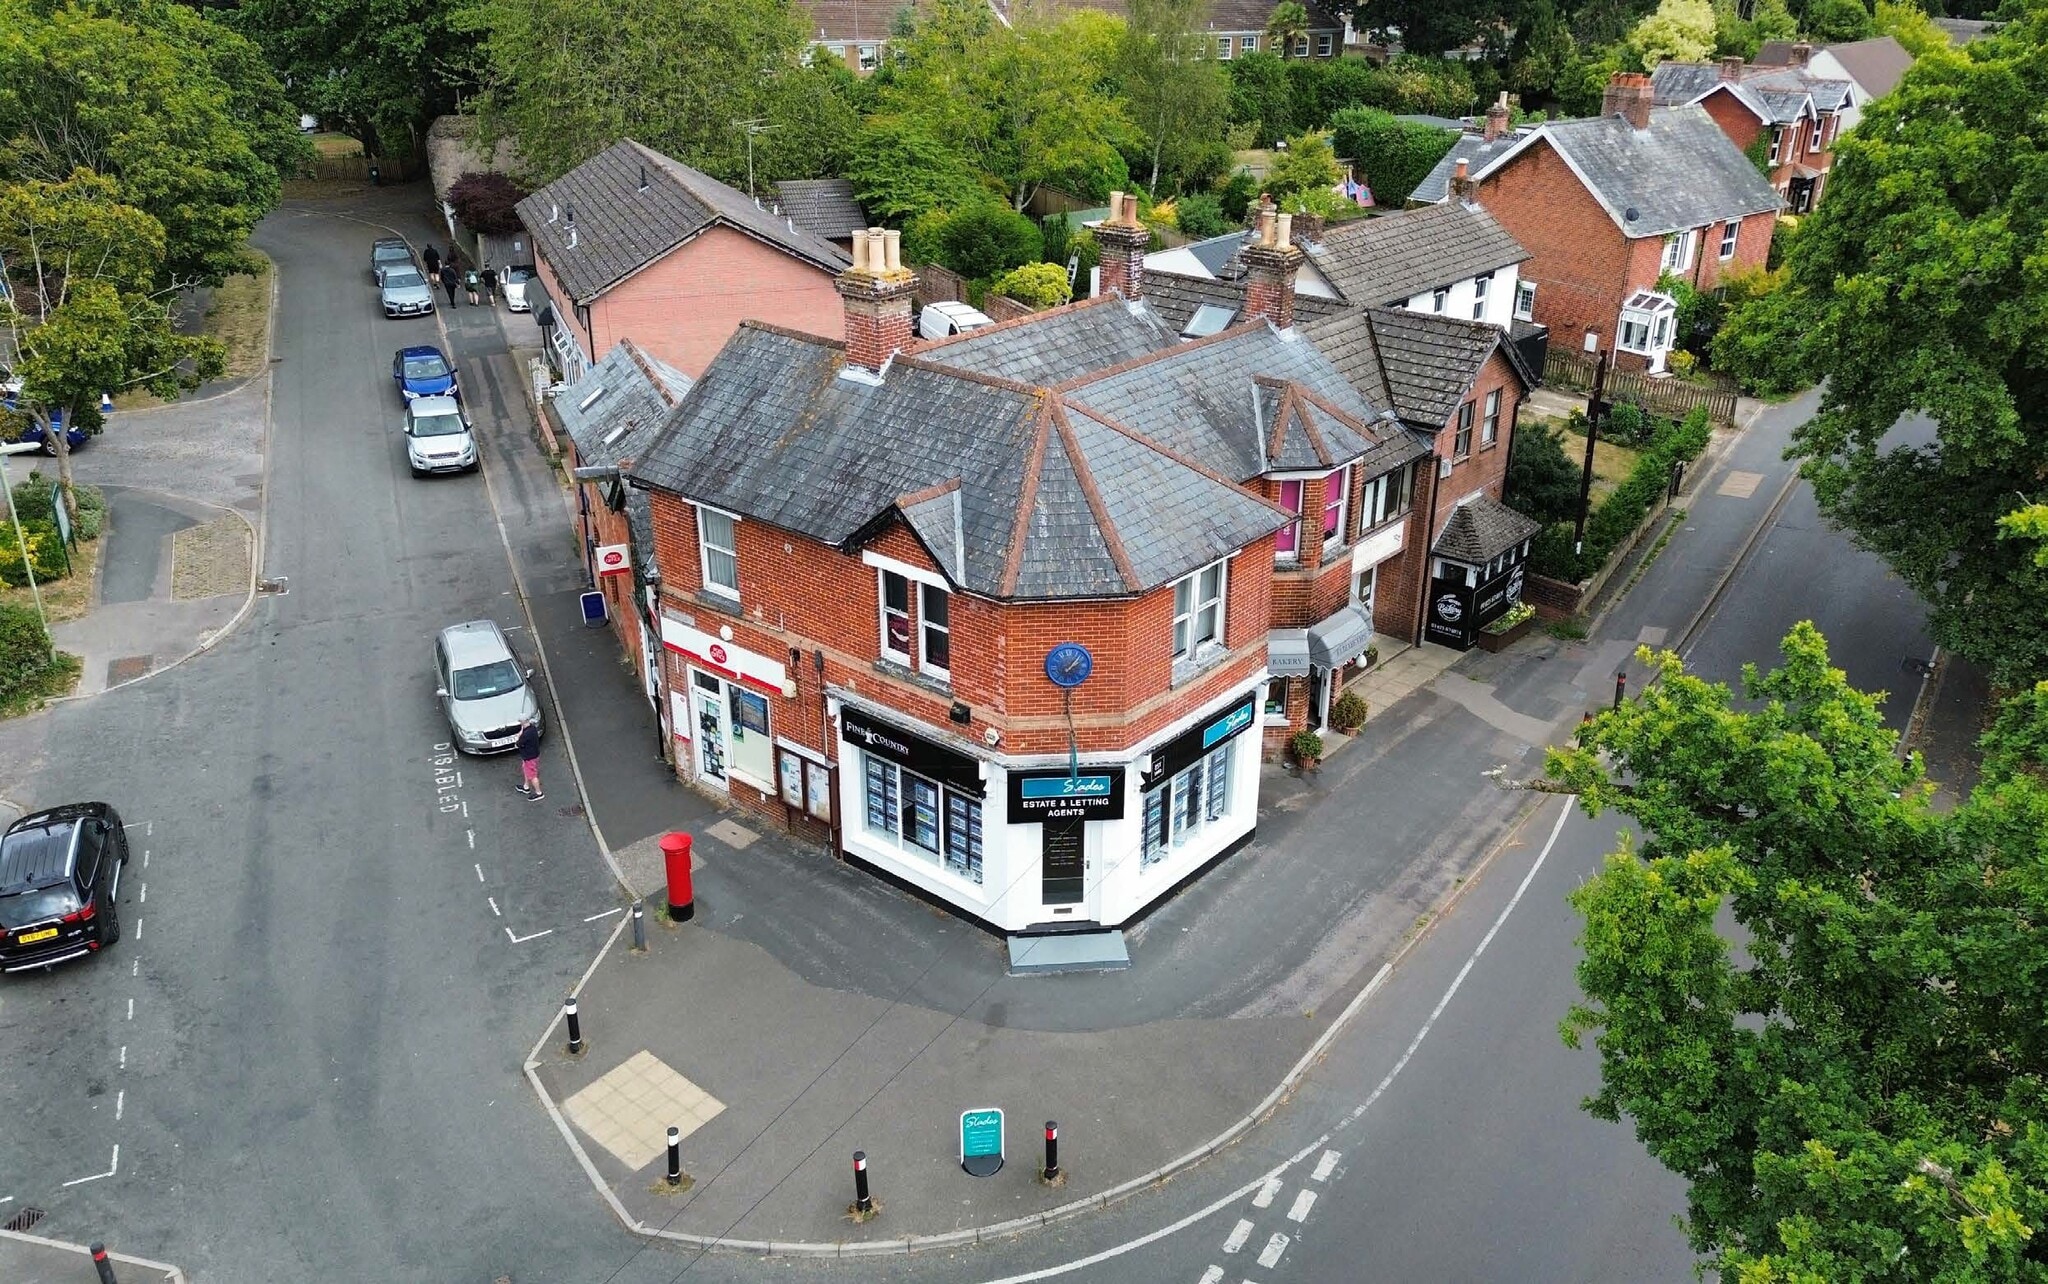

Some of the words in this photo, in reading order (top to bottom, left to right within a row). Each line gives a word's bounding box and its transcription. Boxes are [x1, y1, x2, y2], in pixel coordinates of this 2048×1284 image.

[1272, 658, 1303, 666] BAKERY
[846, 721, 866, 737] FINE
[872, 732, 910, 756] COUNTRY
[433, 742, 460, 813] DISABLED
[1022, 799, 1056, 808] ESTATE
[1059, 799, 1067, 807] &
[1070, 798, 1109, 807] LETTING
[1047, 808, 1085, 817] AGENTS
[965, 1115, 999, 1128] Slades
